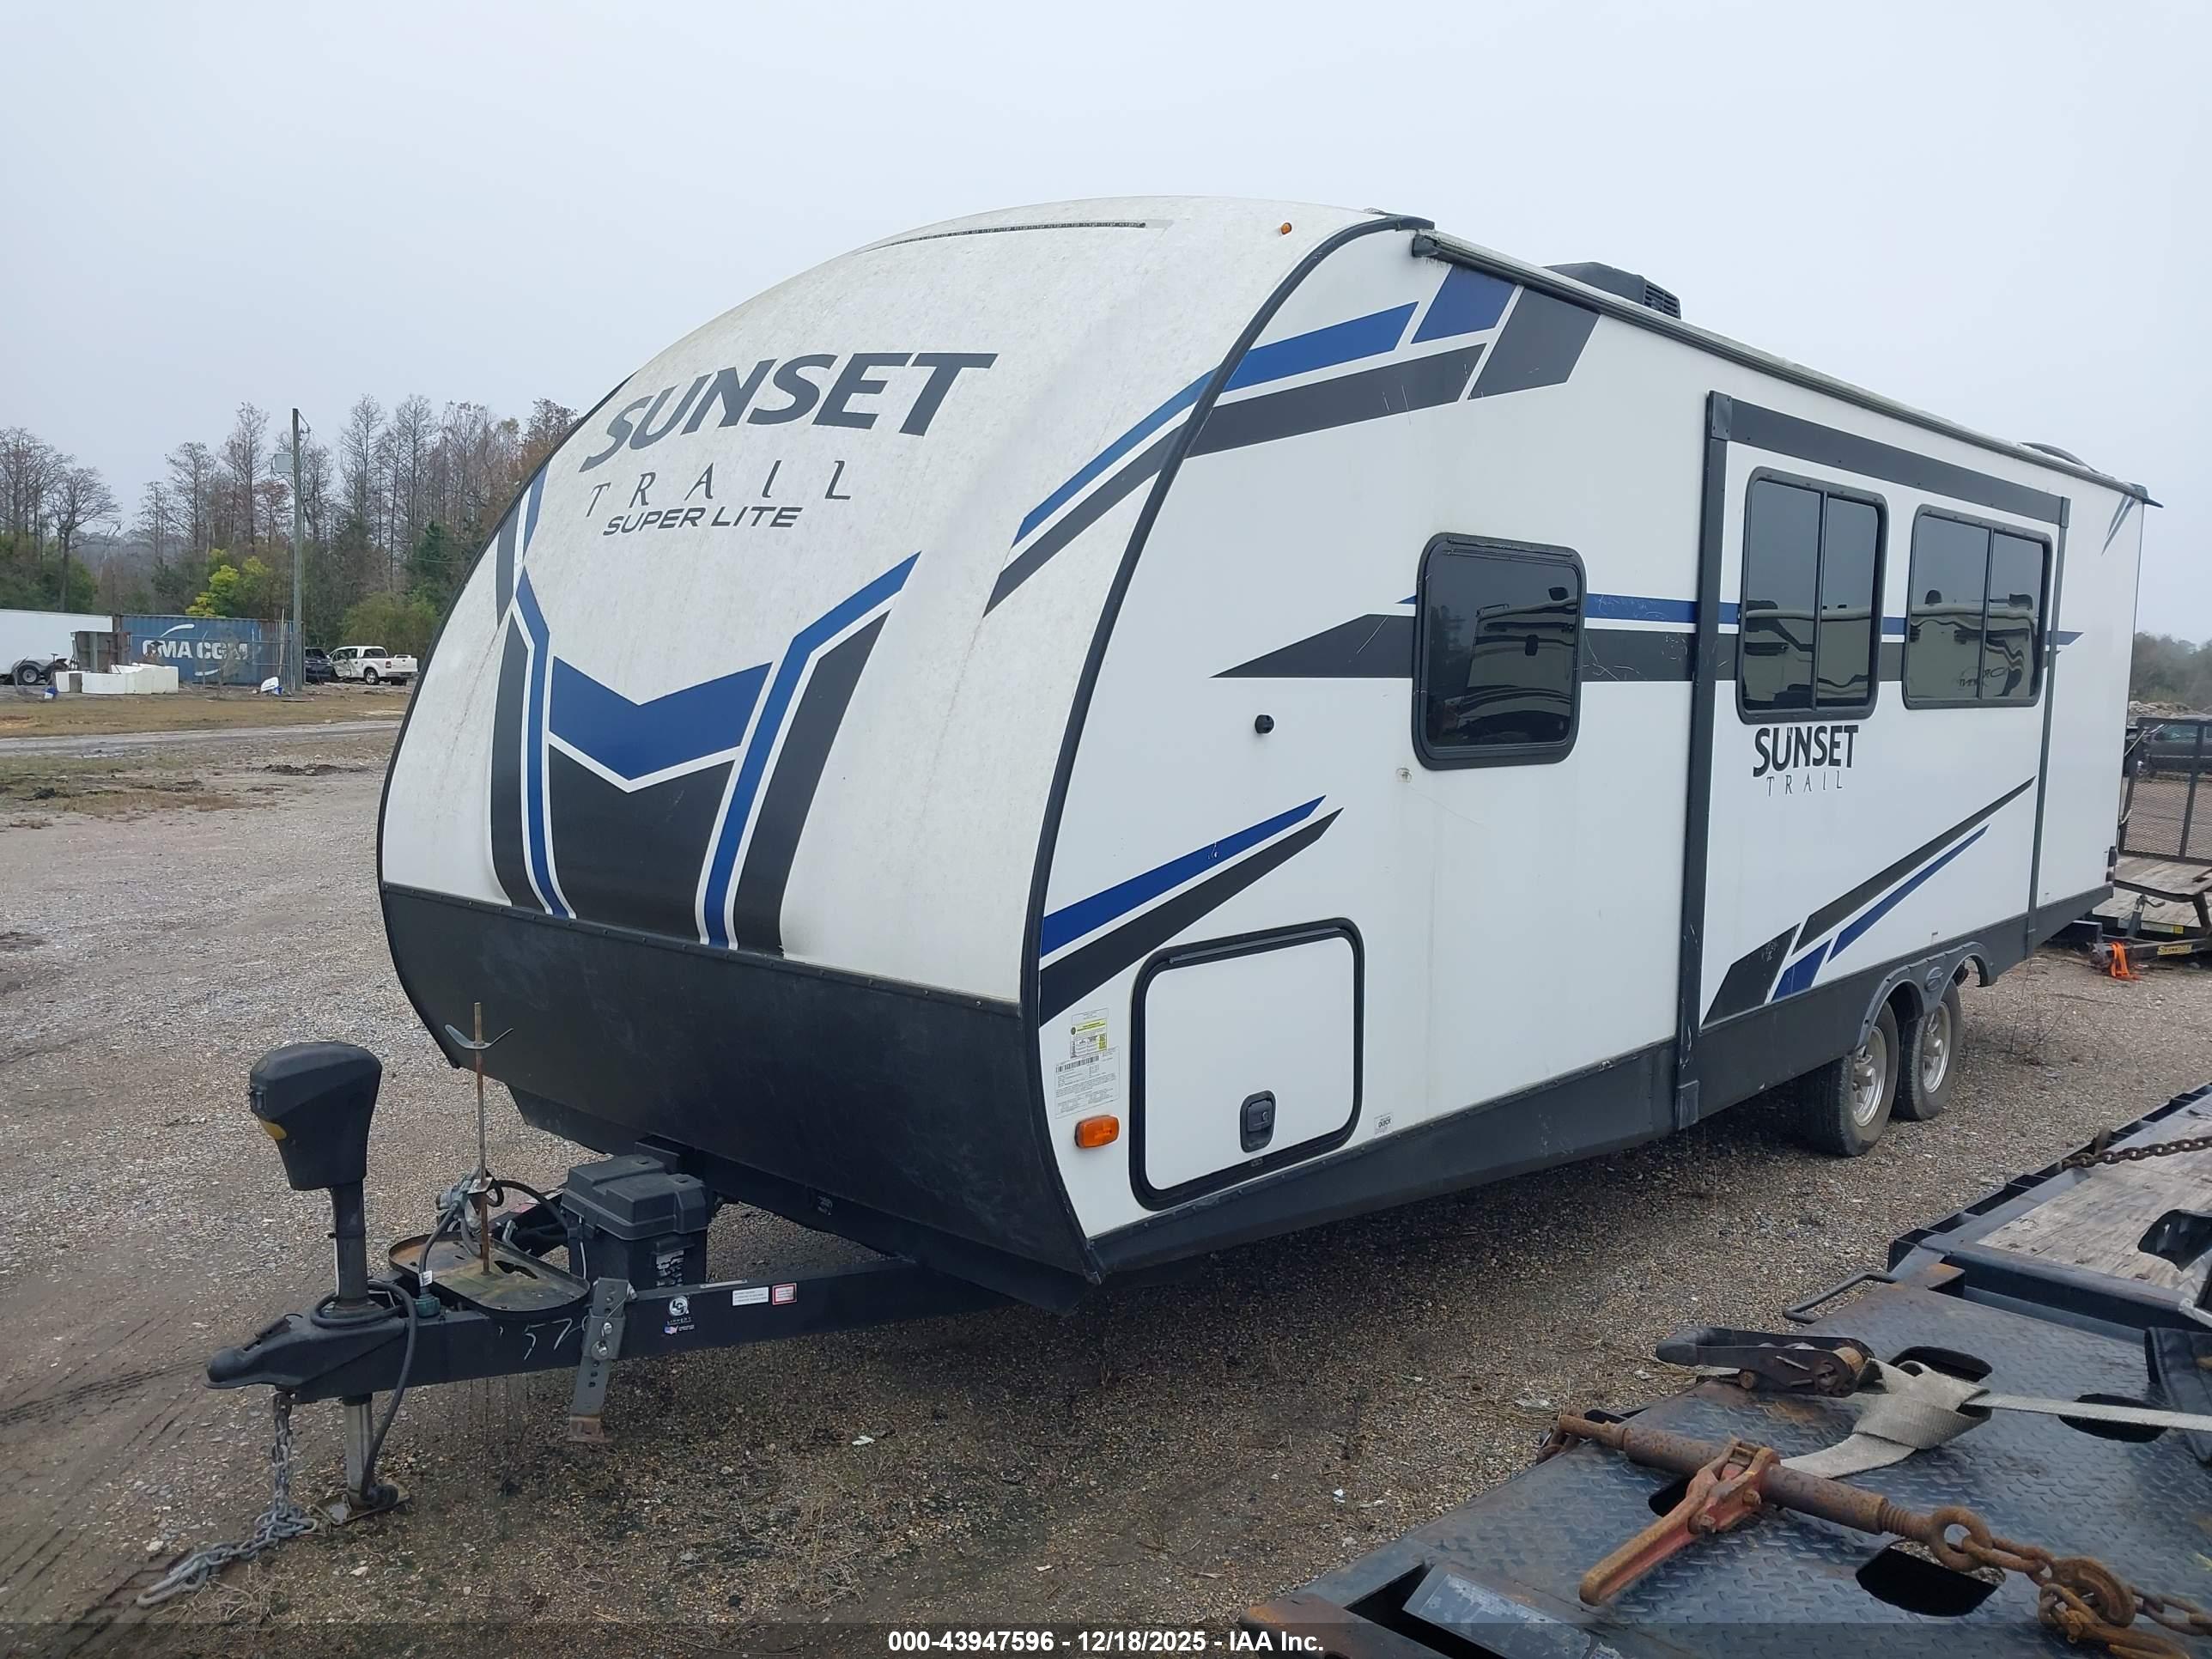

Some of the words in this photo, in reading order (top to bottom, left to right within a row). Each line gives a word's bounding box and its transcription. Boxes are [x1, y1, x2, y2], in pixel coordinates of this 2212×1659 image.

[579, 352, 999, 472] SUNSET
[585, 459, 852, 518] TRAIL
[603, 507, 706, 536] SUPER
[711, 506, 803, 528] LITE
[1753, 724, 1860, 778] SUNSET
[1765, 769, 1844, 797] TRAIL
